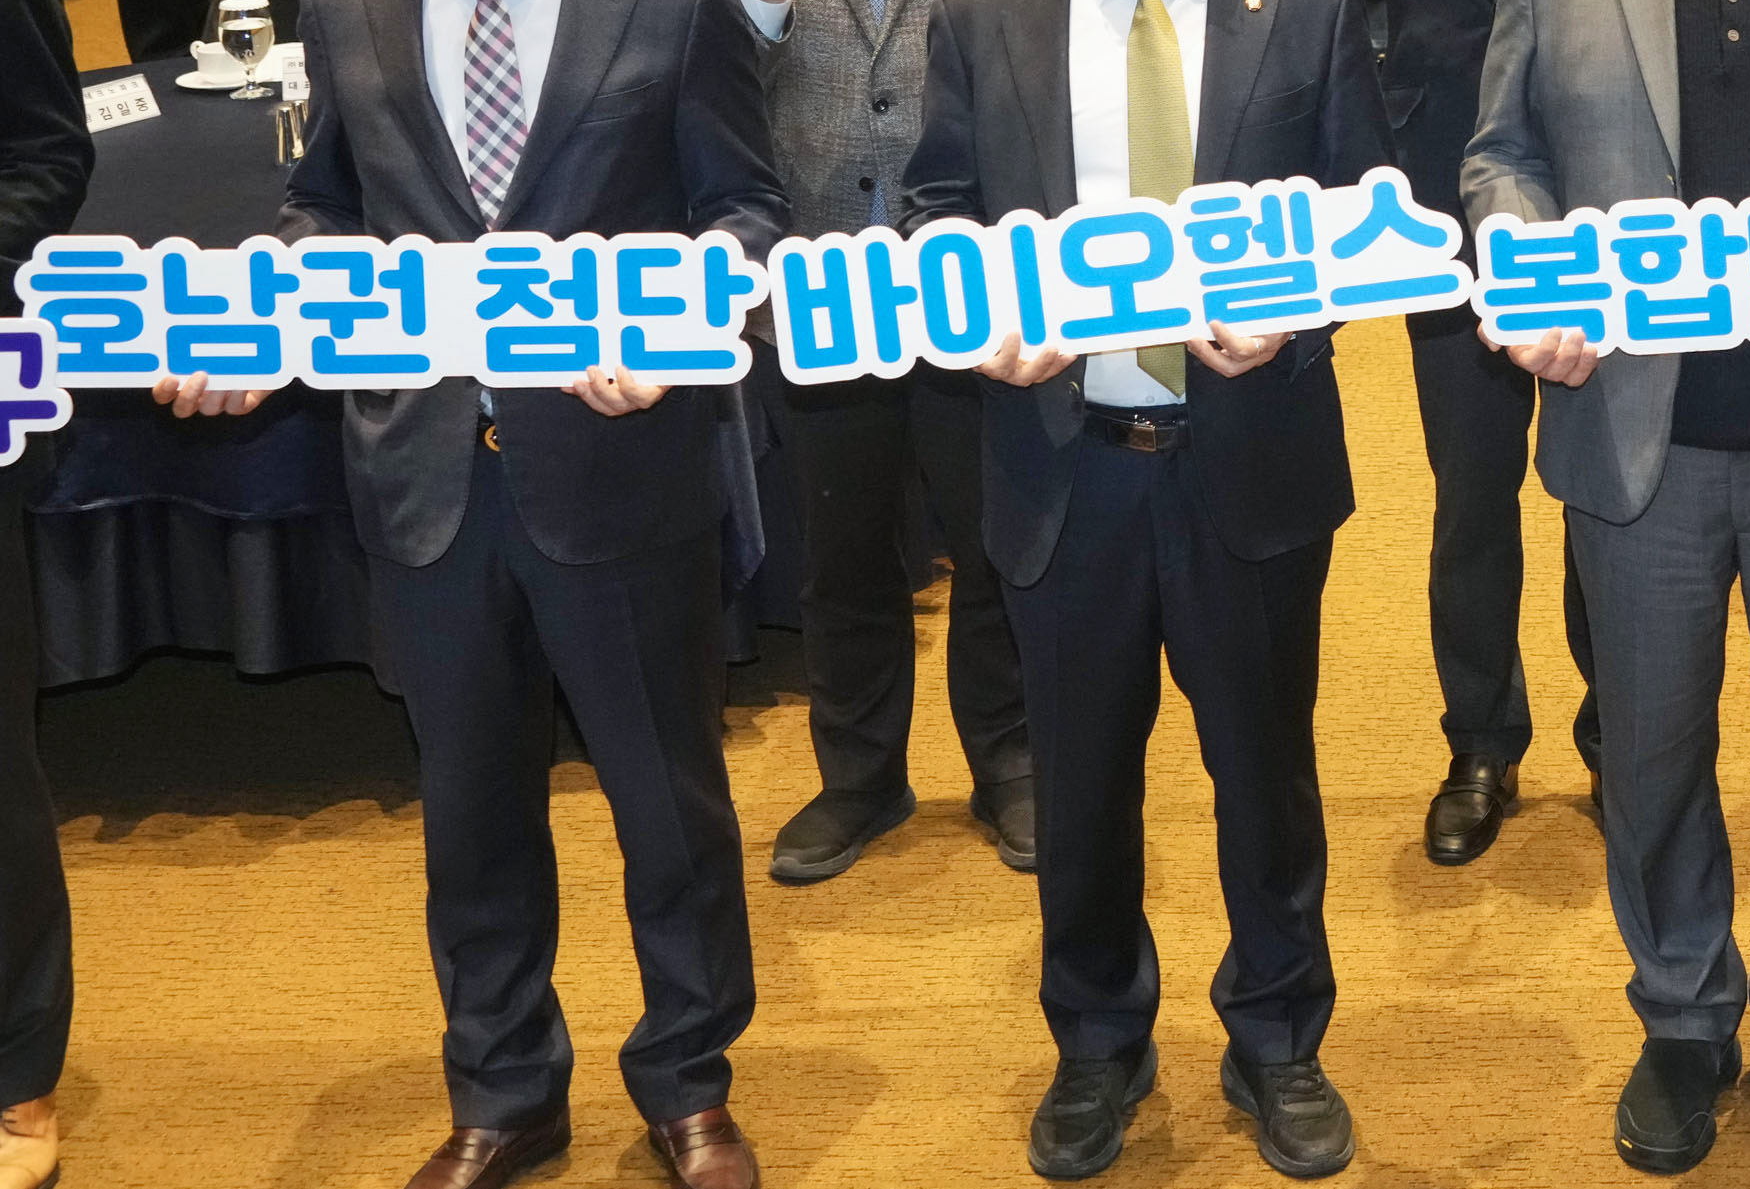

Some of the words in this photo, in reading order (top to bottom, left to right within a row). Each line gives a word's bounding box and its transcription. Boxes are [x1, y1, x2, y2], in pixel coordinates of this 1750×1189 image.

[30, 250, 430, 376] 호남권
[476, 246, 755, 372] 첨단
[783, 181, 1460, 370] 바이오헬스
